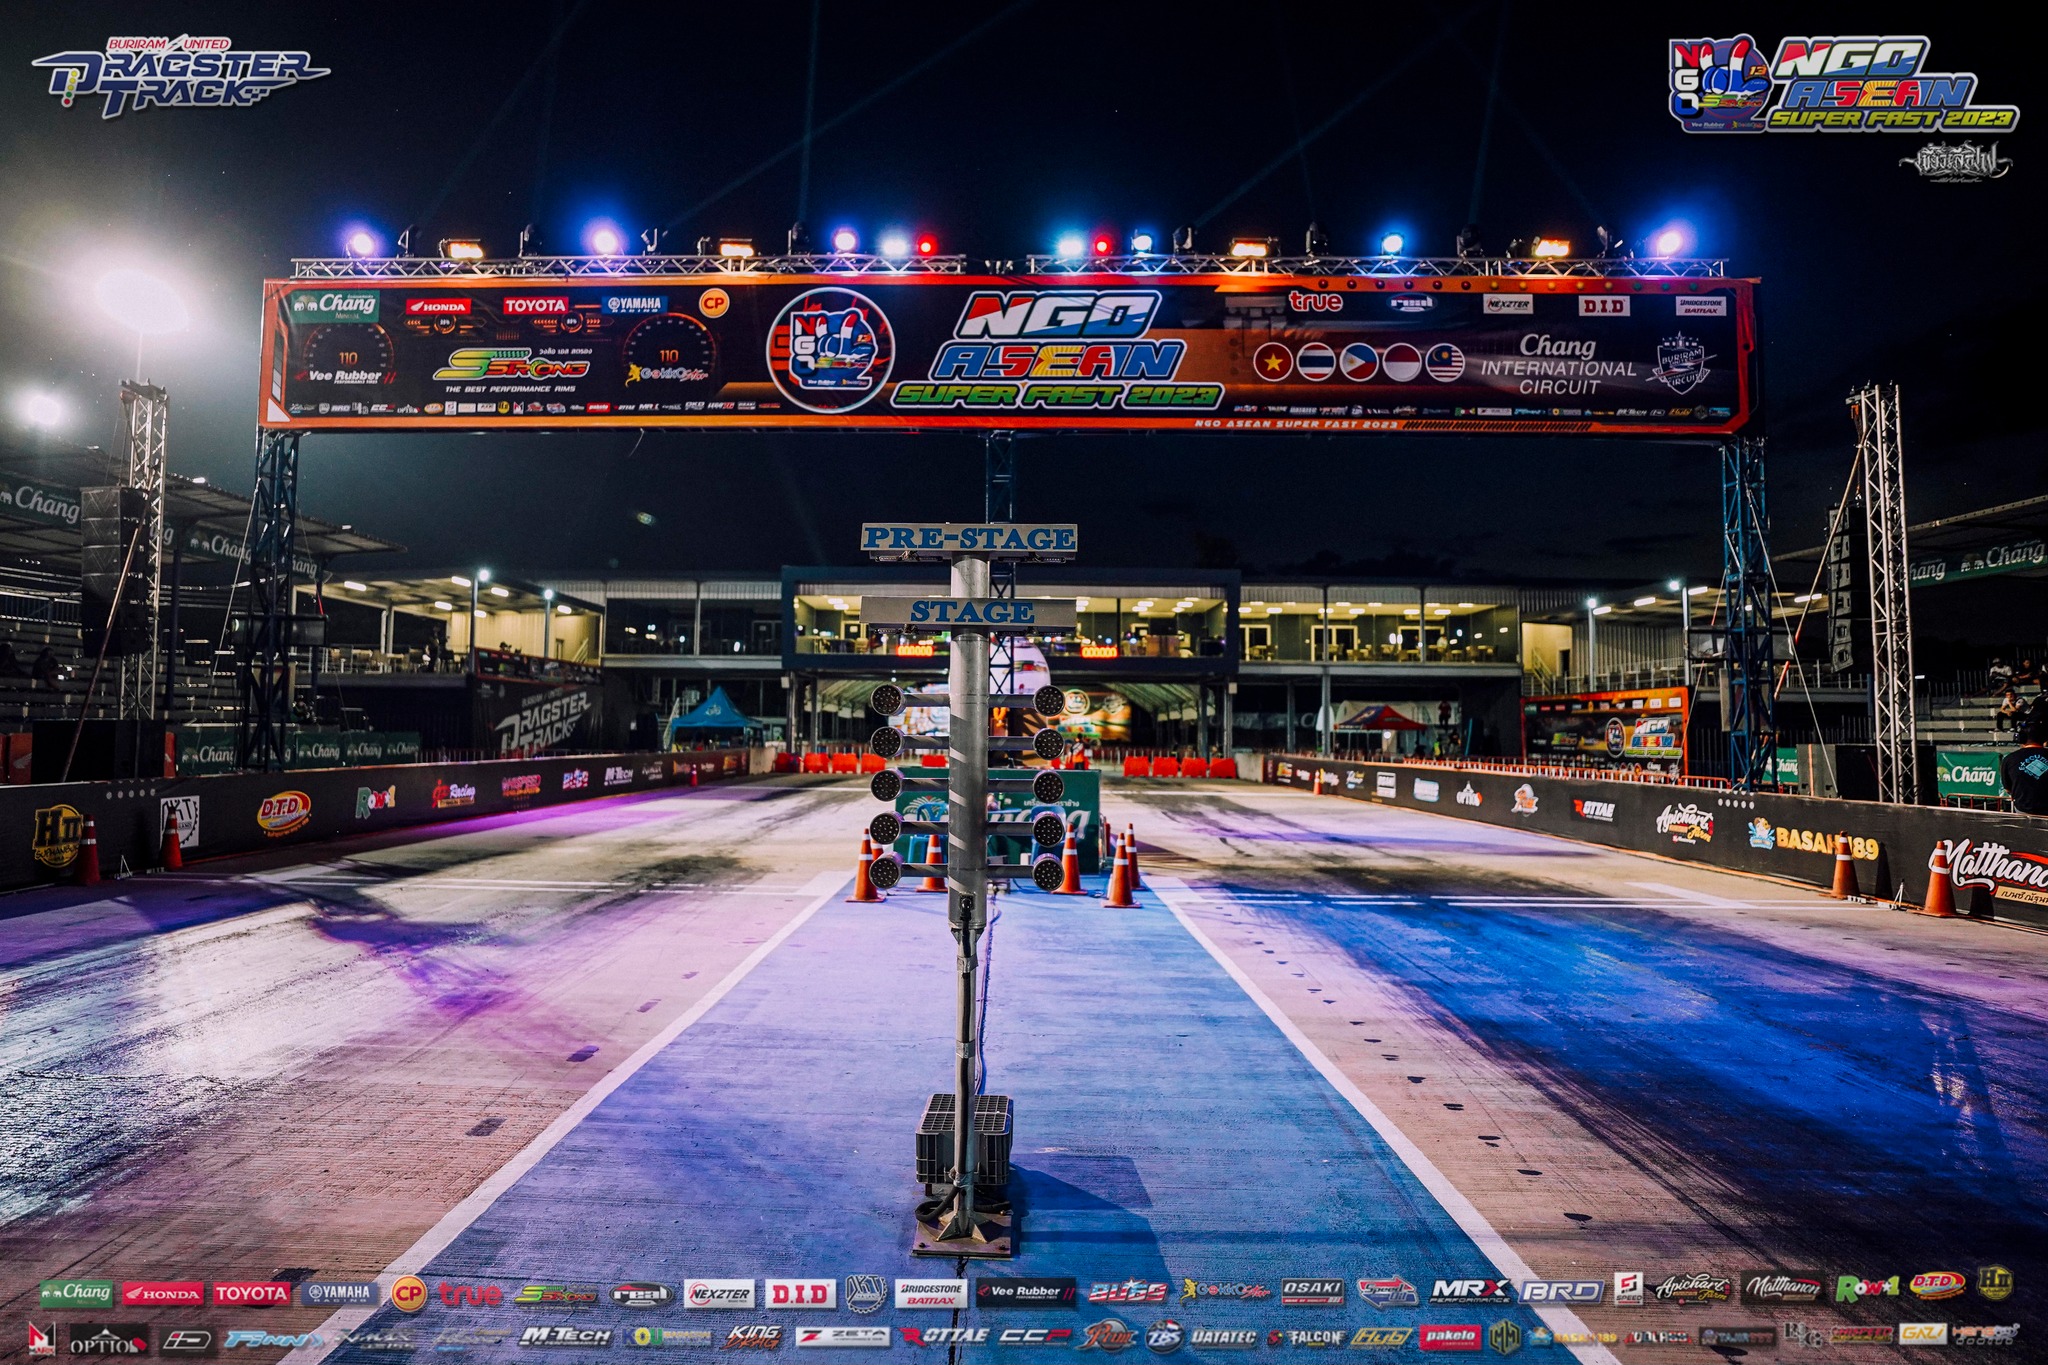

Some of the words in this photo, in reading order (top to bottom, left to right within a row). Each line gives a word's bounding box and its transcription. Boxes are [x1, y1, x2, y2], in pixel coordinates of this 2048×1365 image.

[320, 294, 376, 314] Chang
[423, 303, 466, 312] HONDA
[506, 299, 566, 312] TOYOTA
[620, 298, 661, 309] YAMAHA
[703, 297, 725, 310] CP
[1290, 290, 1343, 312] true
[1487, 300, 1530, 309] NEXZTER
[1584, 299, 1624, 314] D.I.D
[1680, 299, 1723, 307] BRIDGESTONE
[966, 297, 1155, 335] NGO
[660, 349, 679, 362] 110
[1520, 333, 1597, 360] Chang
[339, 352, 358, 366] 110
[933, 345, 1179, 378] ASEAN
[1662, 348, 1701, 365] BURIRAM
[309, 370, 333, 380] Vee
[335, 370, 382, 381] Rubber
[1481, 360, 1638, 377] INTERNATIONAL
[445, 385, 462, 393] THE
[465, 385, 487, 393] BEST
[490, 385, 551, 393] PERFORMANCE
[554, 385, 576, 393] RIMS
[897, 385, 1021, 403] SUPER
[1022, 385, 1122, 403] FAST
[1127, 385, 1221, 404] 2023
[1519, 379, 1601, 395] CIRCUIT
[1195, 420, 1221, 428] NGO
[1226, 420, 1271, 428] ASEAN
[1276, 420, 1319, 428] SUPER
[1324, 420, 1358, 428] FAST
[1362, 421, 1398, 429] 2023
[15, 486, 80, 525] Chang
[863, 527, 1076, 550] PRE-STAGE
[211, 535, 252, 564] Chang
[1986, 541, 2046, 568] Chang
[292, 555, 318, 580] hang
[1908, 560, 1946, 581] hang
[910, 600, 1035, 623] STAGE
[495, 691, 592, 754] DRAGSTER
[520, 713, 582, 759] TRACK
[312, 742, 339, 759] Chang
[1952, 766, 1996, 786] Chang
[1656, 803, 1713, 833] Apichart
